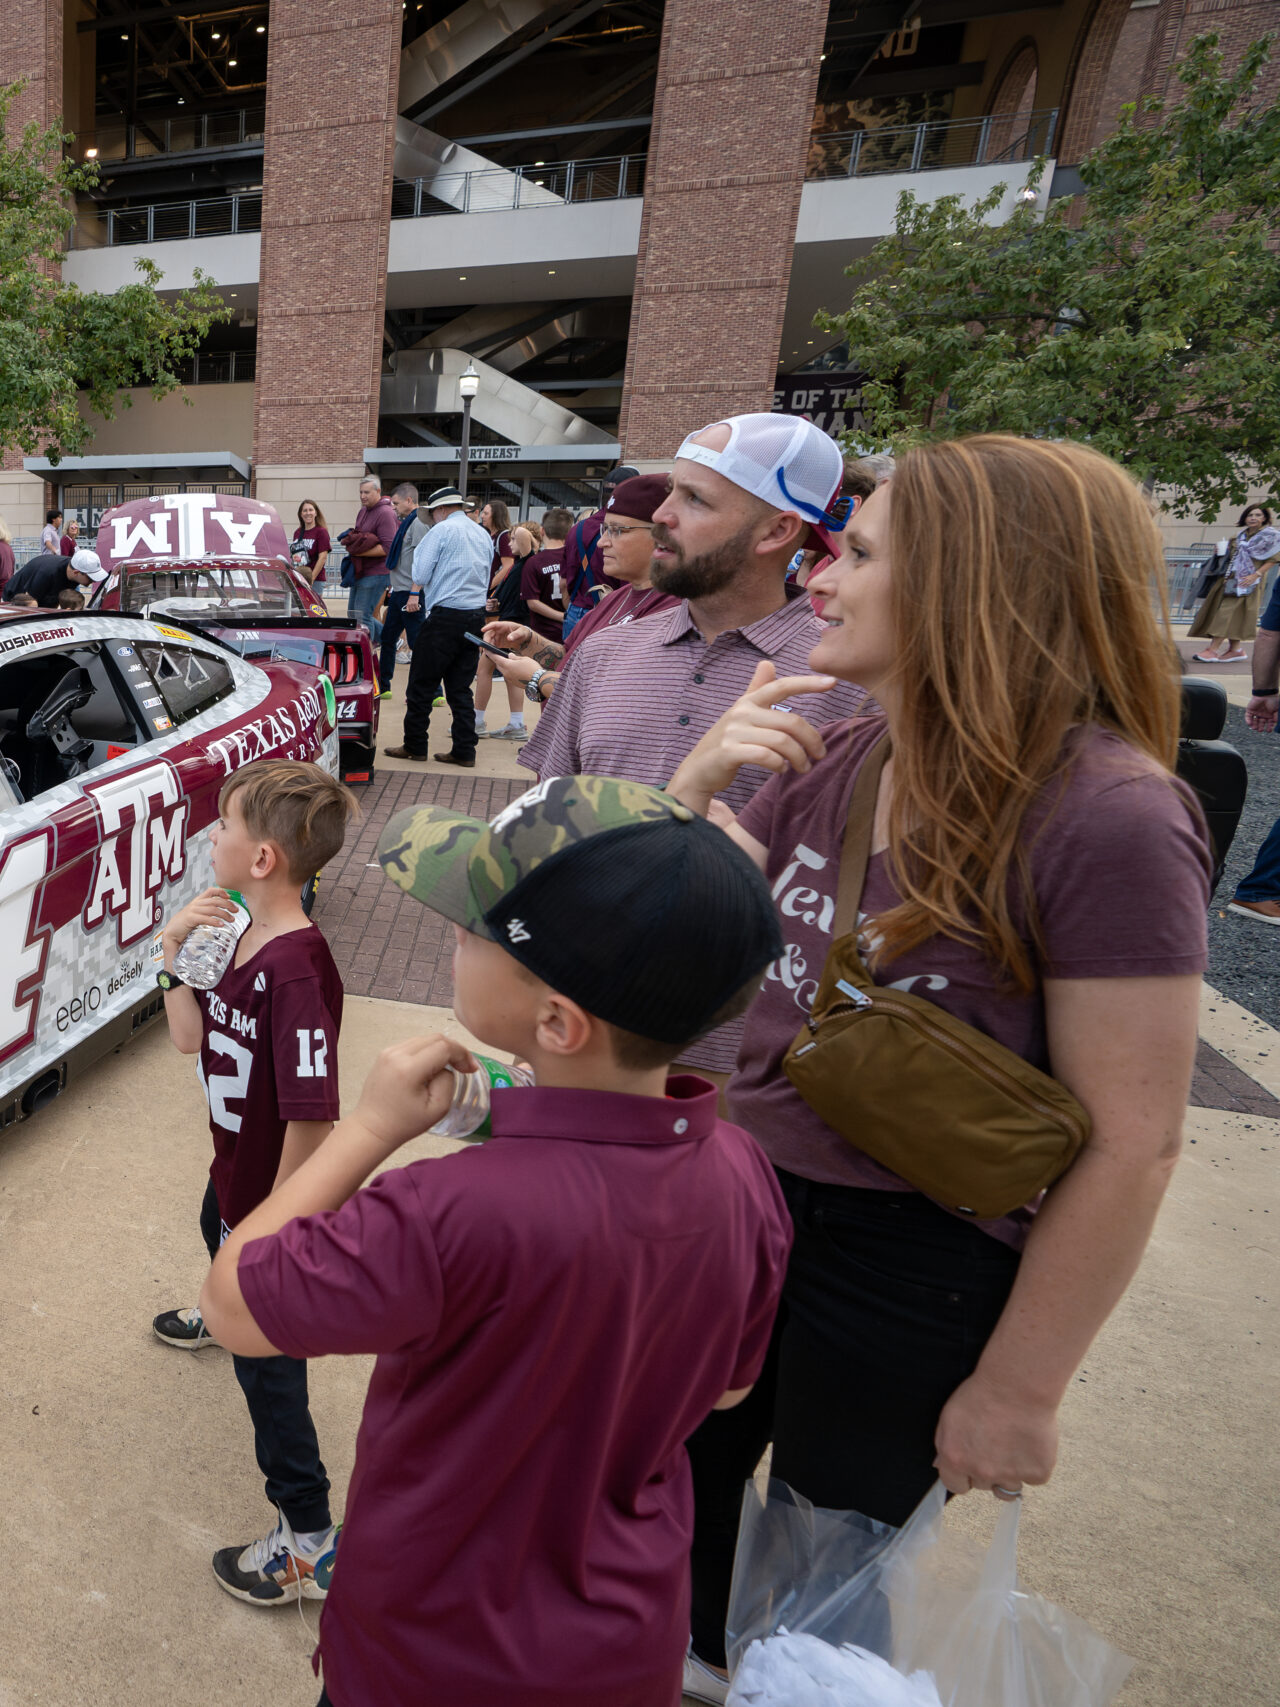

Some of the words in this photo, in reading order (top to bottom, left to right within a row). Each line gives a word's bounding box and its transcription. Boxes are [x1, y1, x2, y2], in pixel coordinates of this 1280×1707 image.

[791, 390, 824, 409] OF
[830, 388, 873, 408] TH
[455, 448, 521, 459] NRTHEAST
[337, 700, 358, 719] 14
[206, 706, 297, 777] TEXAS
[291, 686, 322, 732] A&M
[107, 961, 144, 996] decisely
[56, 986, 101, 1032] eero
[296, 1028, 328, 1078] 12
[196, 1030, 254, 1134] 2
